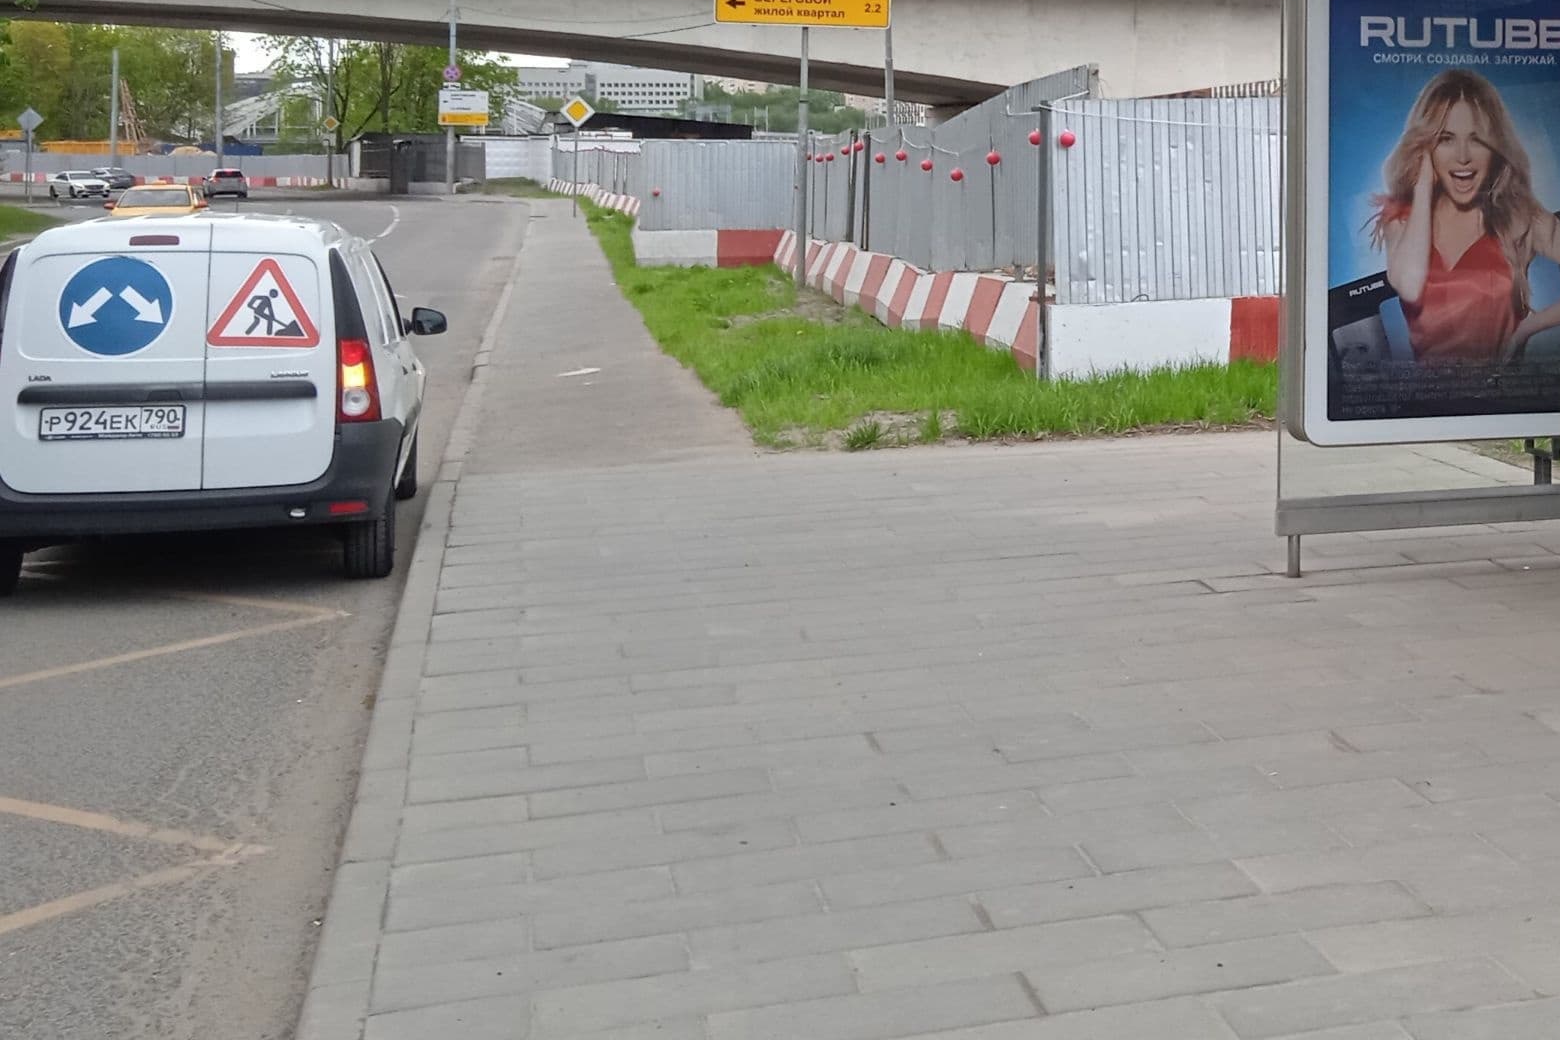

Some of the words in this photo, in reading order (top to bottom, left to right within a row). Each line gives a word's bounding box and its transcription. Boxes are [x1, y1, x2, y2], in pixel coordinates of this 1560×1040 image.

[754, 6, 793, 17] жилой
[797, 9, 845, 19] квартал
[864, 3, 881, 14] 2.2
[1349, 280, 1385, 297] RUTUBE
[143, 409, 177, 424] 790
